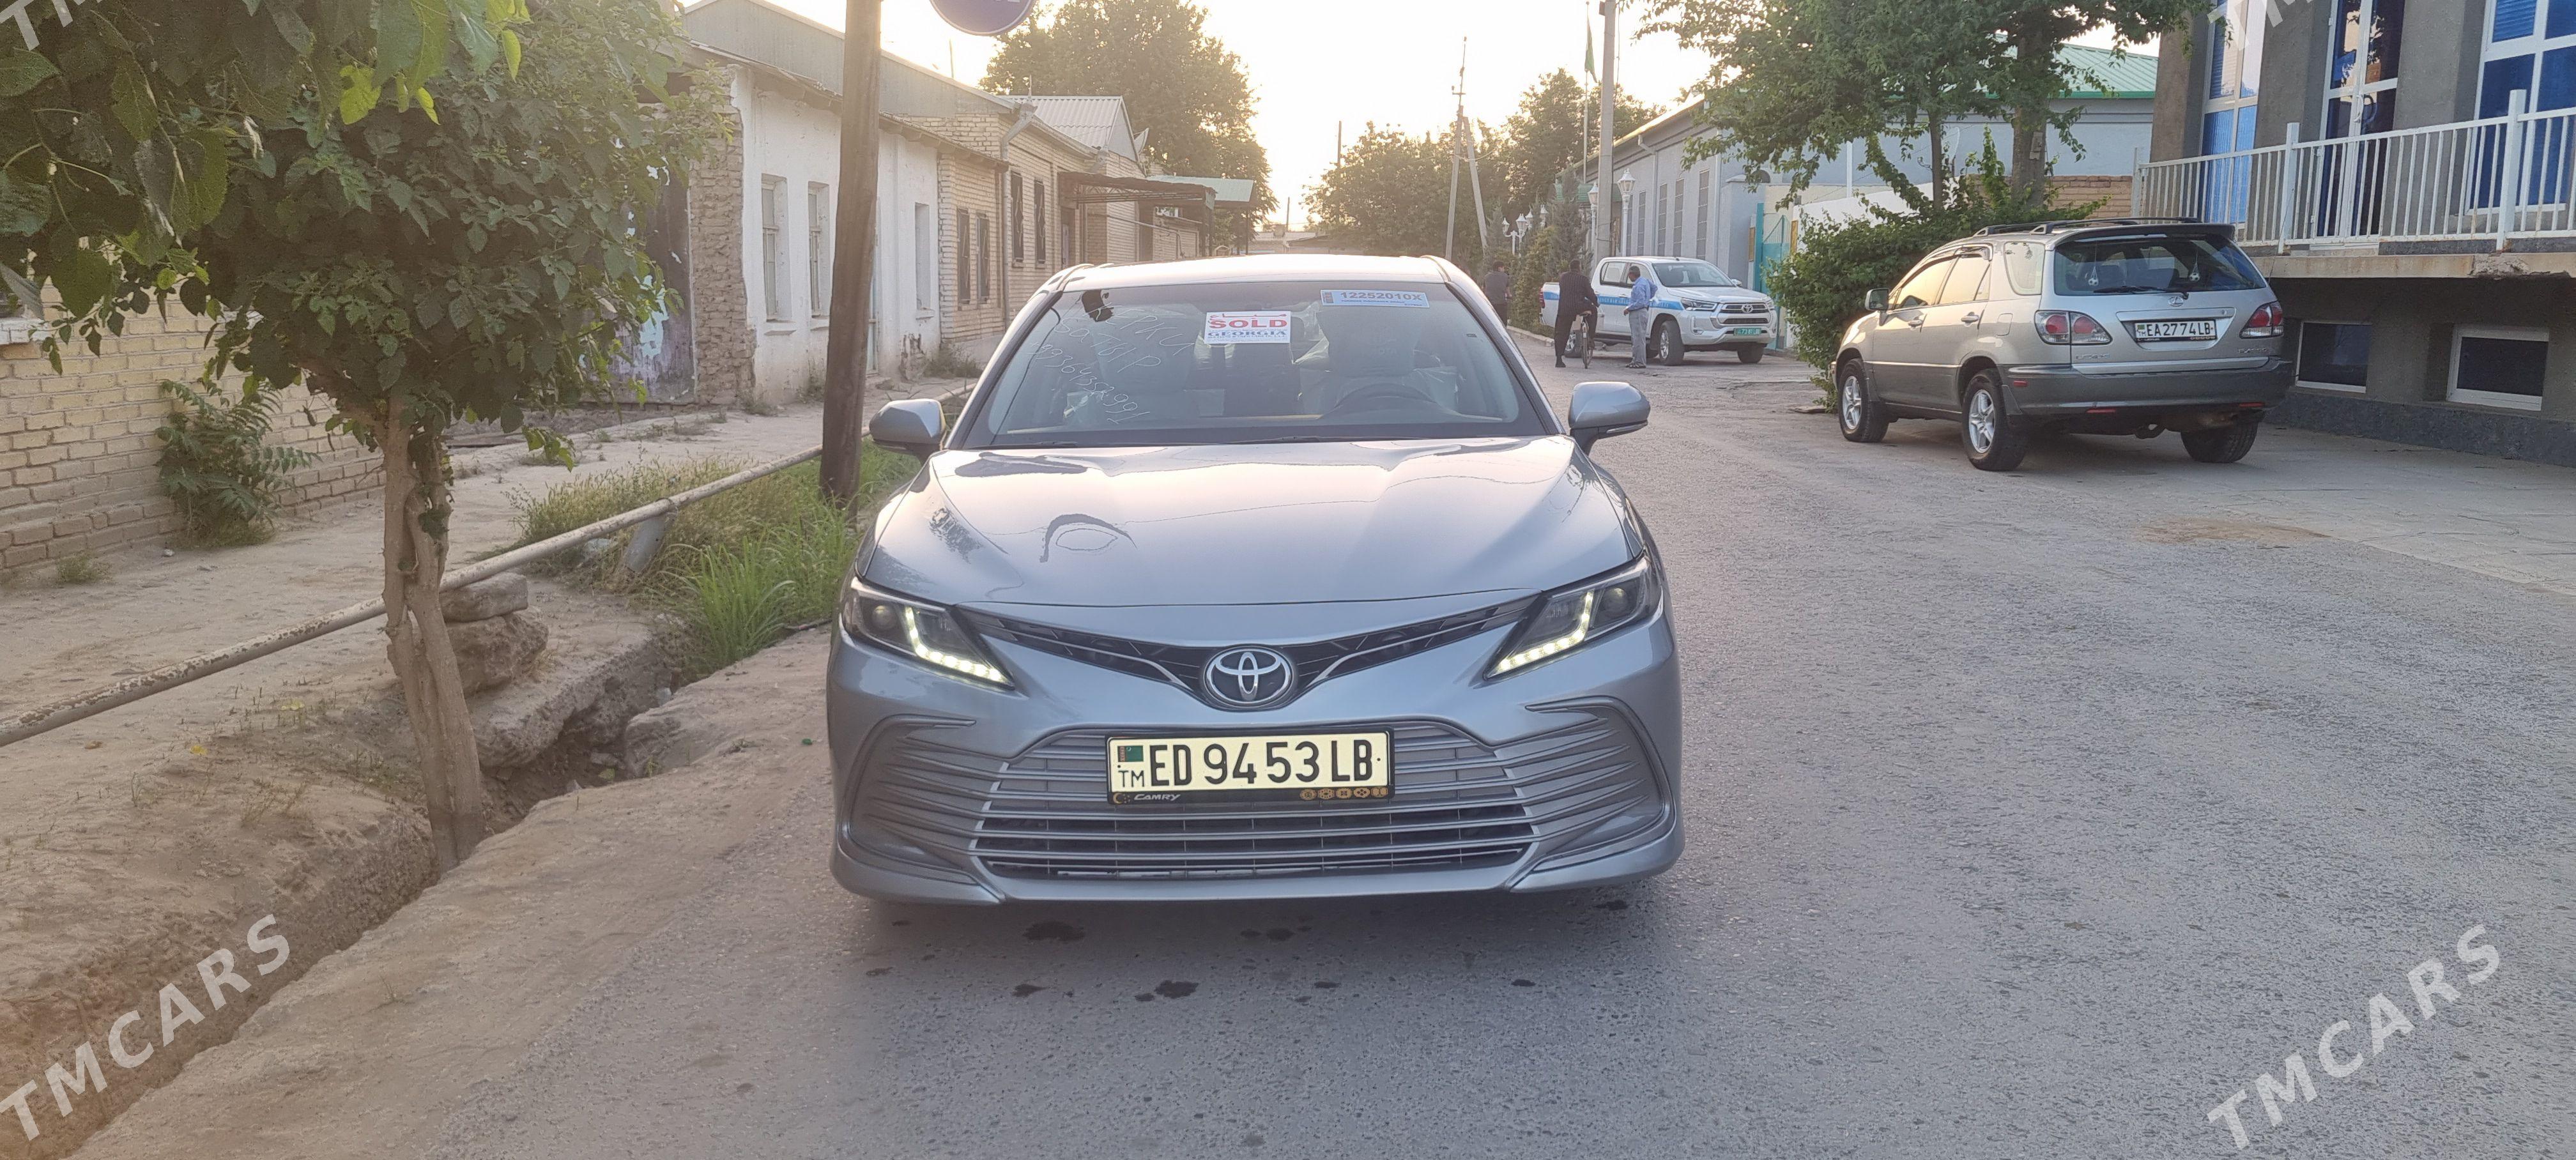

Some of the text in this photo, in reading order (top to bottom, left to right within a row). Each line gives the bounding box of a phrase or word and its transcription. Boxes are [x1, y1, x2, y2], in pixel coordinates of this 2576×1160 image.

[1209, 319, 1288, 328] SOLD
[1118, 770, 1145, 788] TM
[1134, 793, 1181, 802] CAMRY
